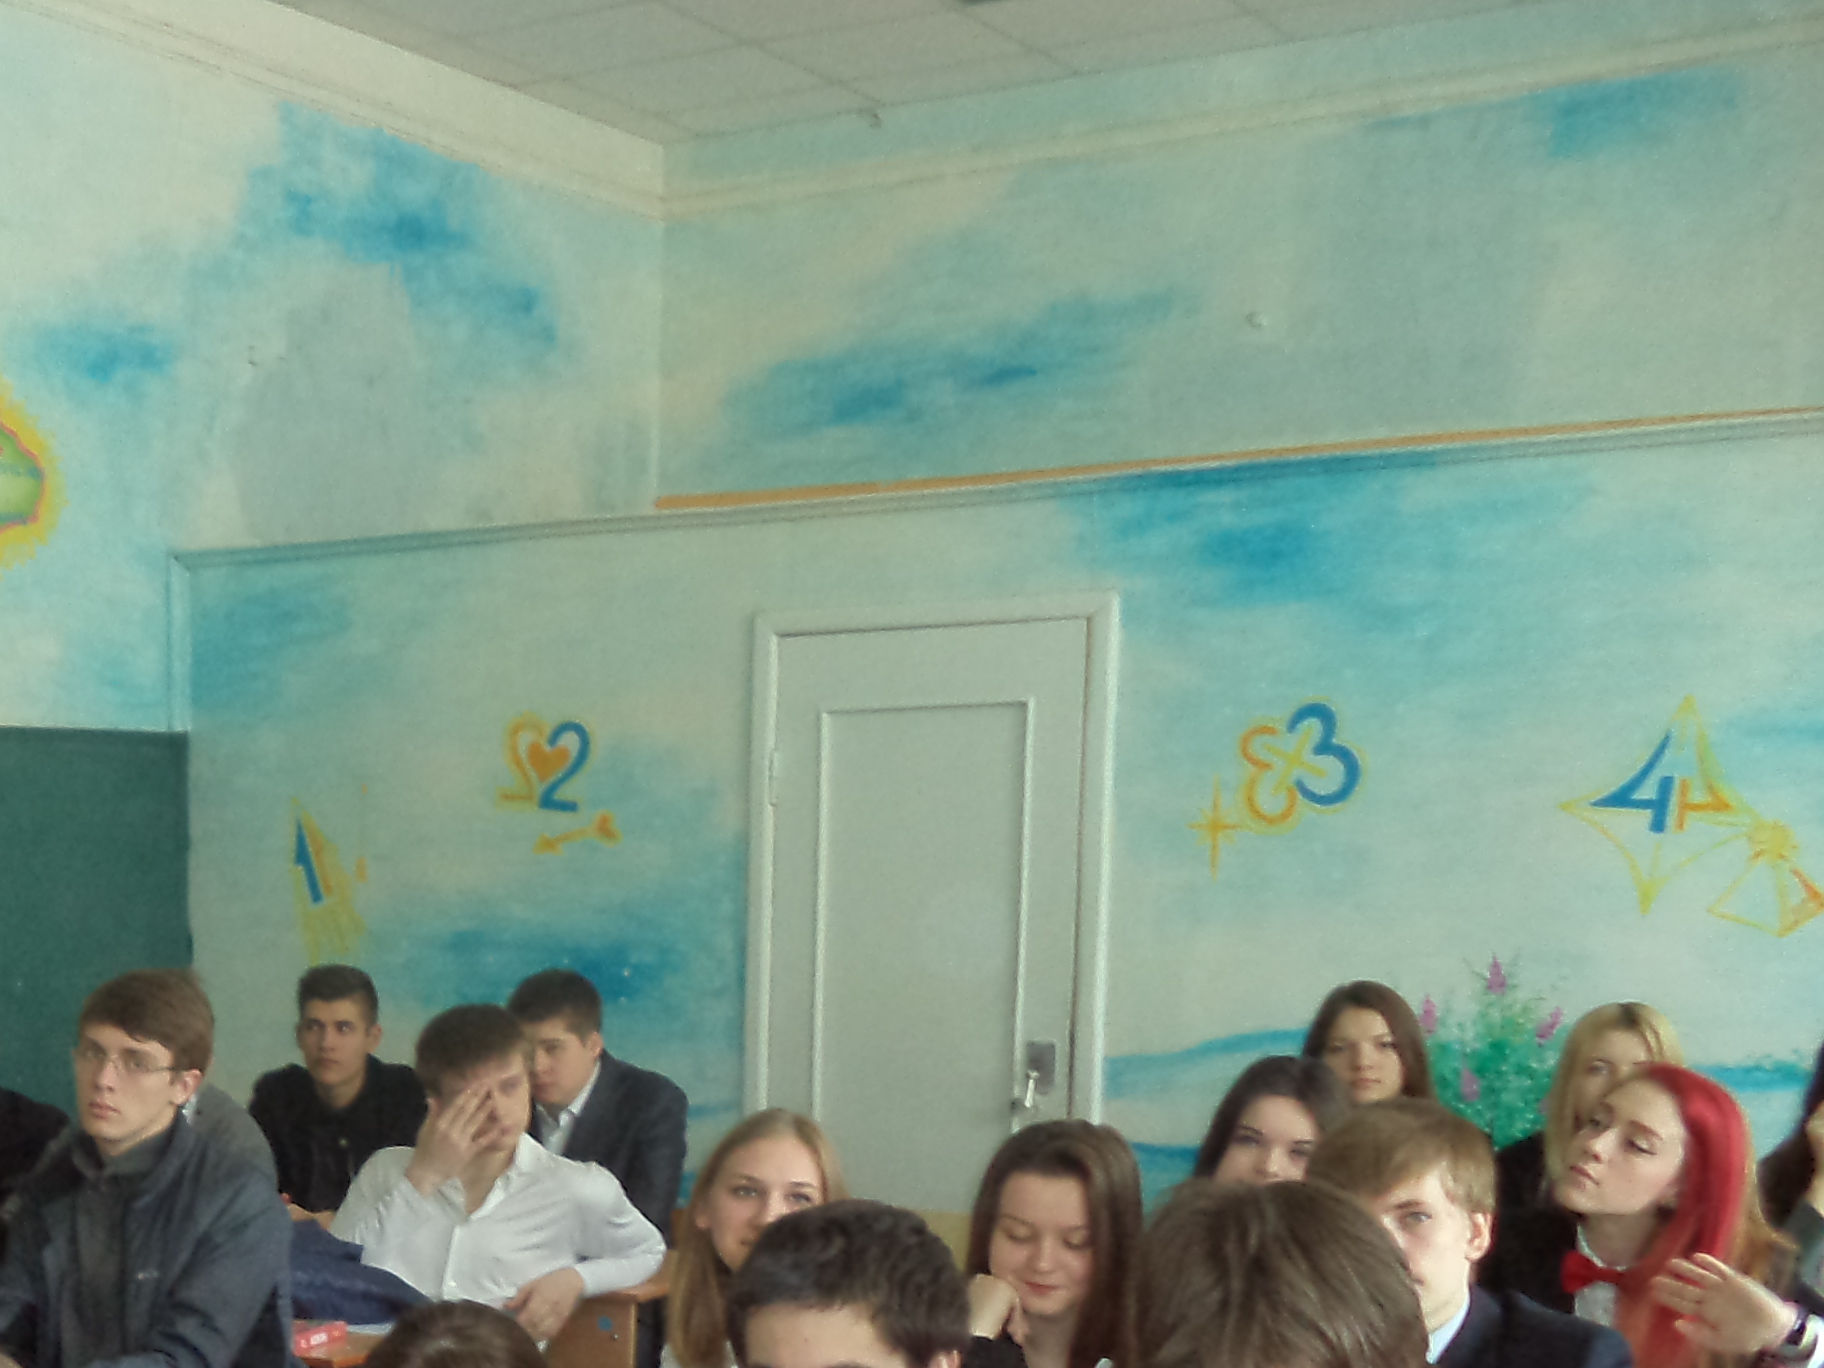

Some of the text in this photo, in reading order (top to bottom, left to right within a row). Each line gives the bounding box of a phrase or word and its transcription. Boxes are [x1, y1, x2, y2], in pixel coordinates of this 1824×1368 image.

[539, 720, 591, 813] 2
[1286, 702, 1363, 807] 3
[1588, 728, 1675, 834] 4
[293, 818, 325, 905] 1
